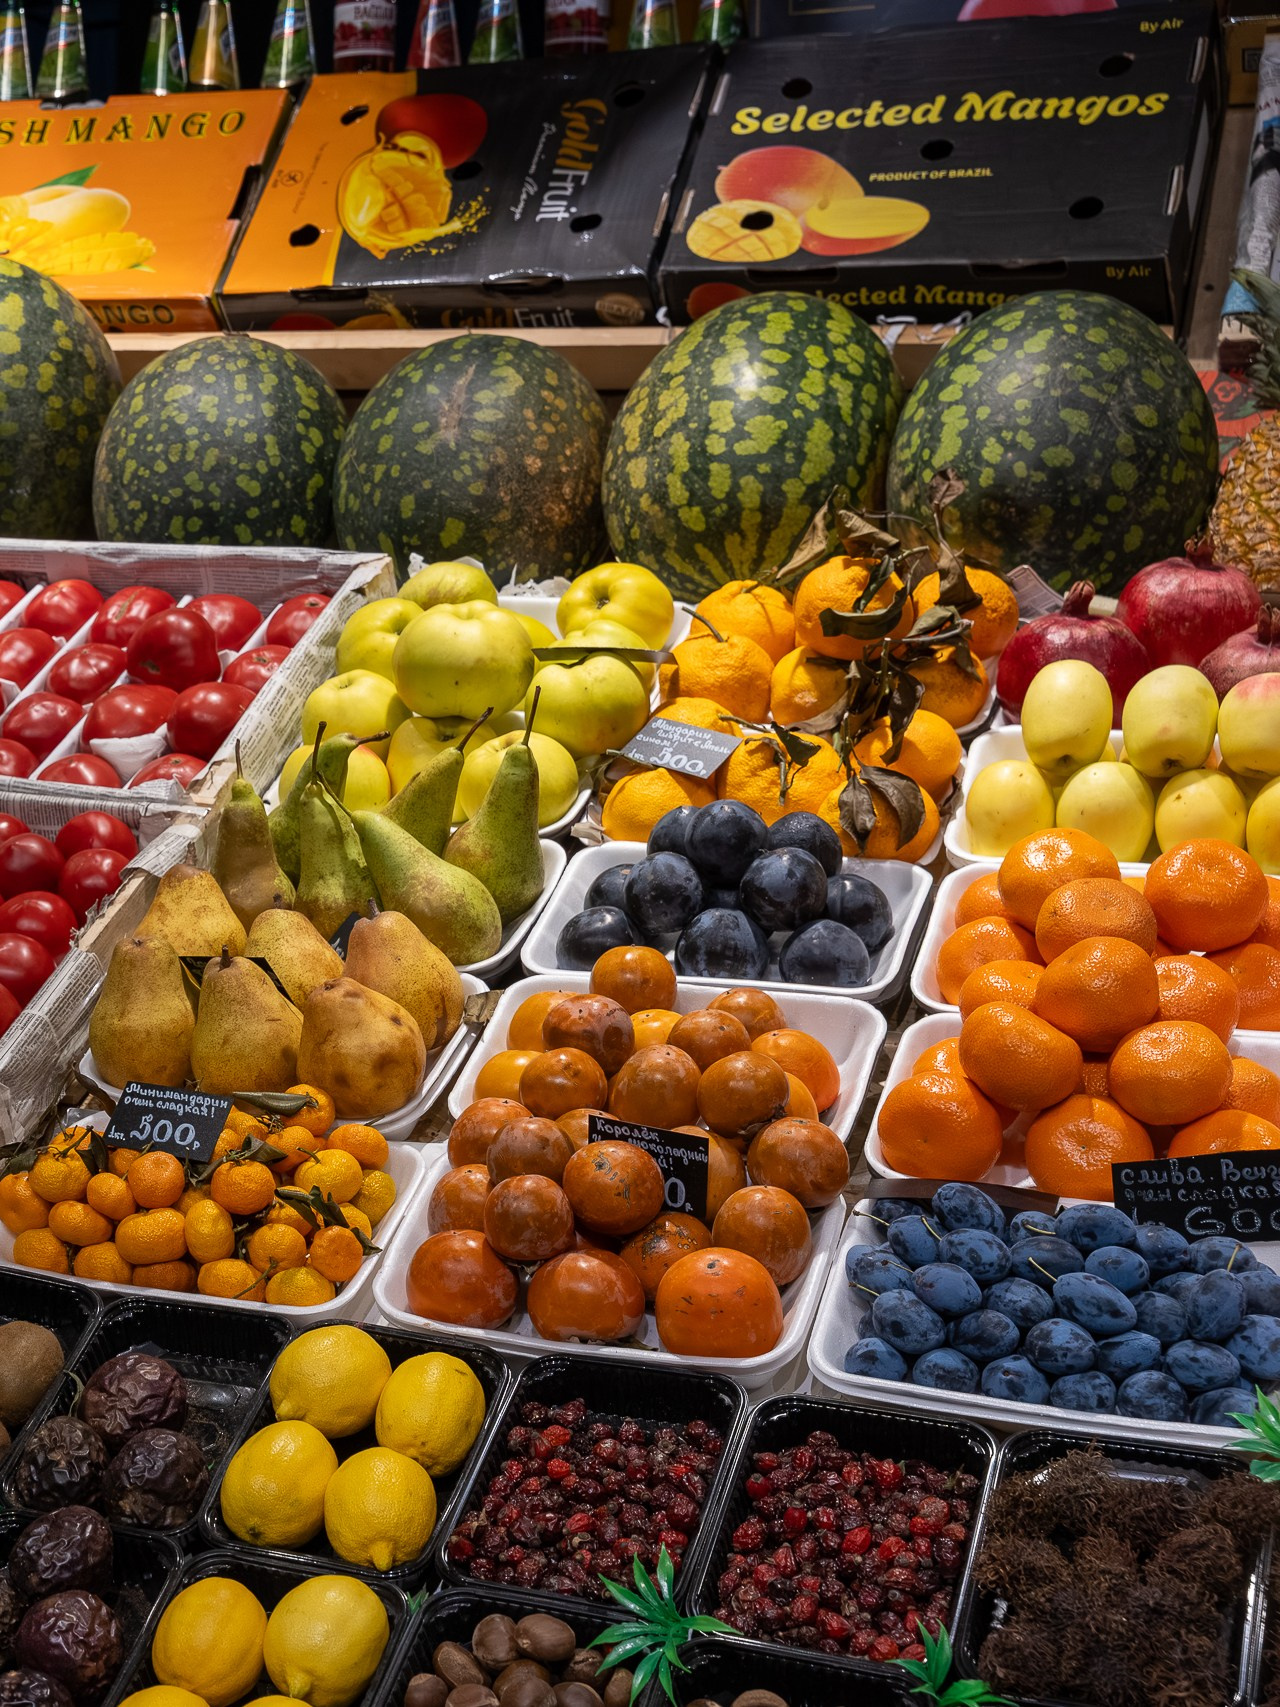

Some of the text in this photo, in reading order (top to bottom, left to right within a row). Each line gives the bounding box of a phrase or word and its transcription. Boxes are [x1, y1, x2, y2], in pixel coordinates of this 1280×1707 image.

[1139, 17, 1185, 34] By Air
[730, 90, 1170, 136] Selected Mangos
[64, 110, 248, 145] MANGO
[868, 167, 994, 183] PRODUCT OF BRAZIL
[1106, 264, 1153, 279] By Air
[816, 285, 906, 305] lected
[86, 304, 175, 325] ANGO
[1220, 1159, 1280, 1182] Венг
